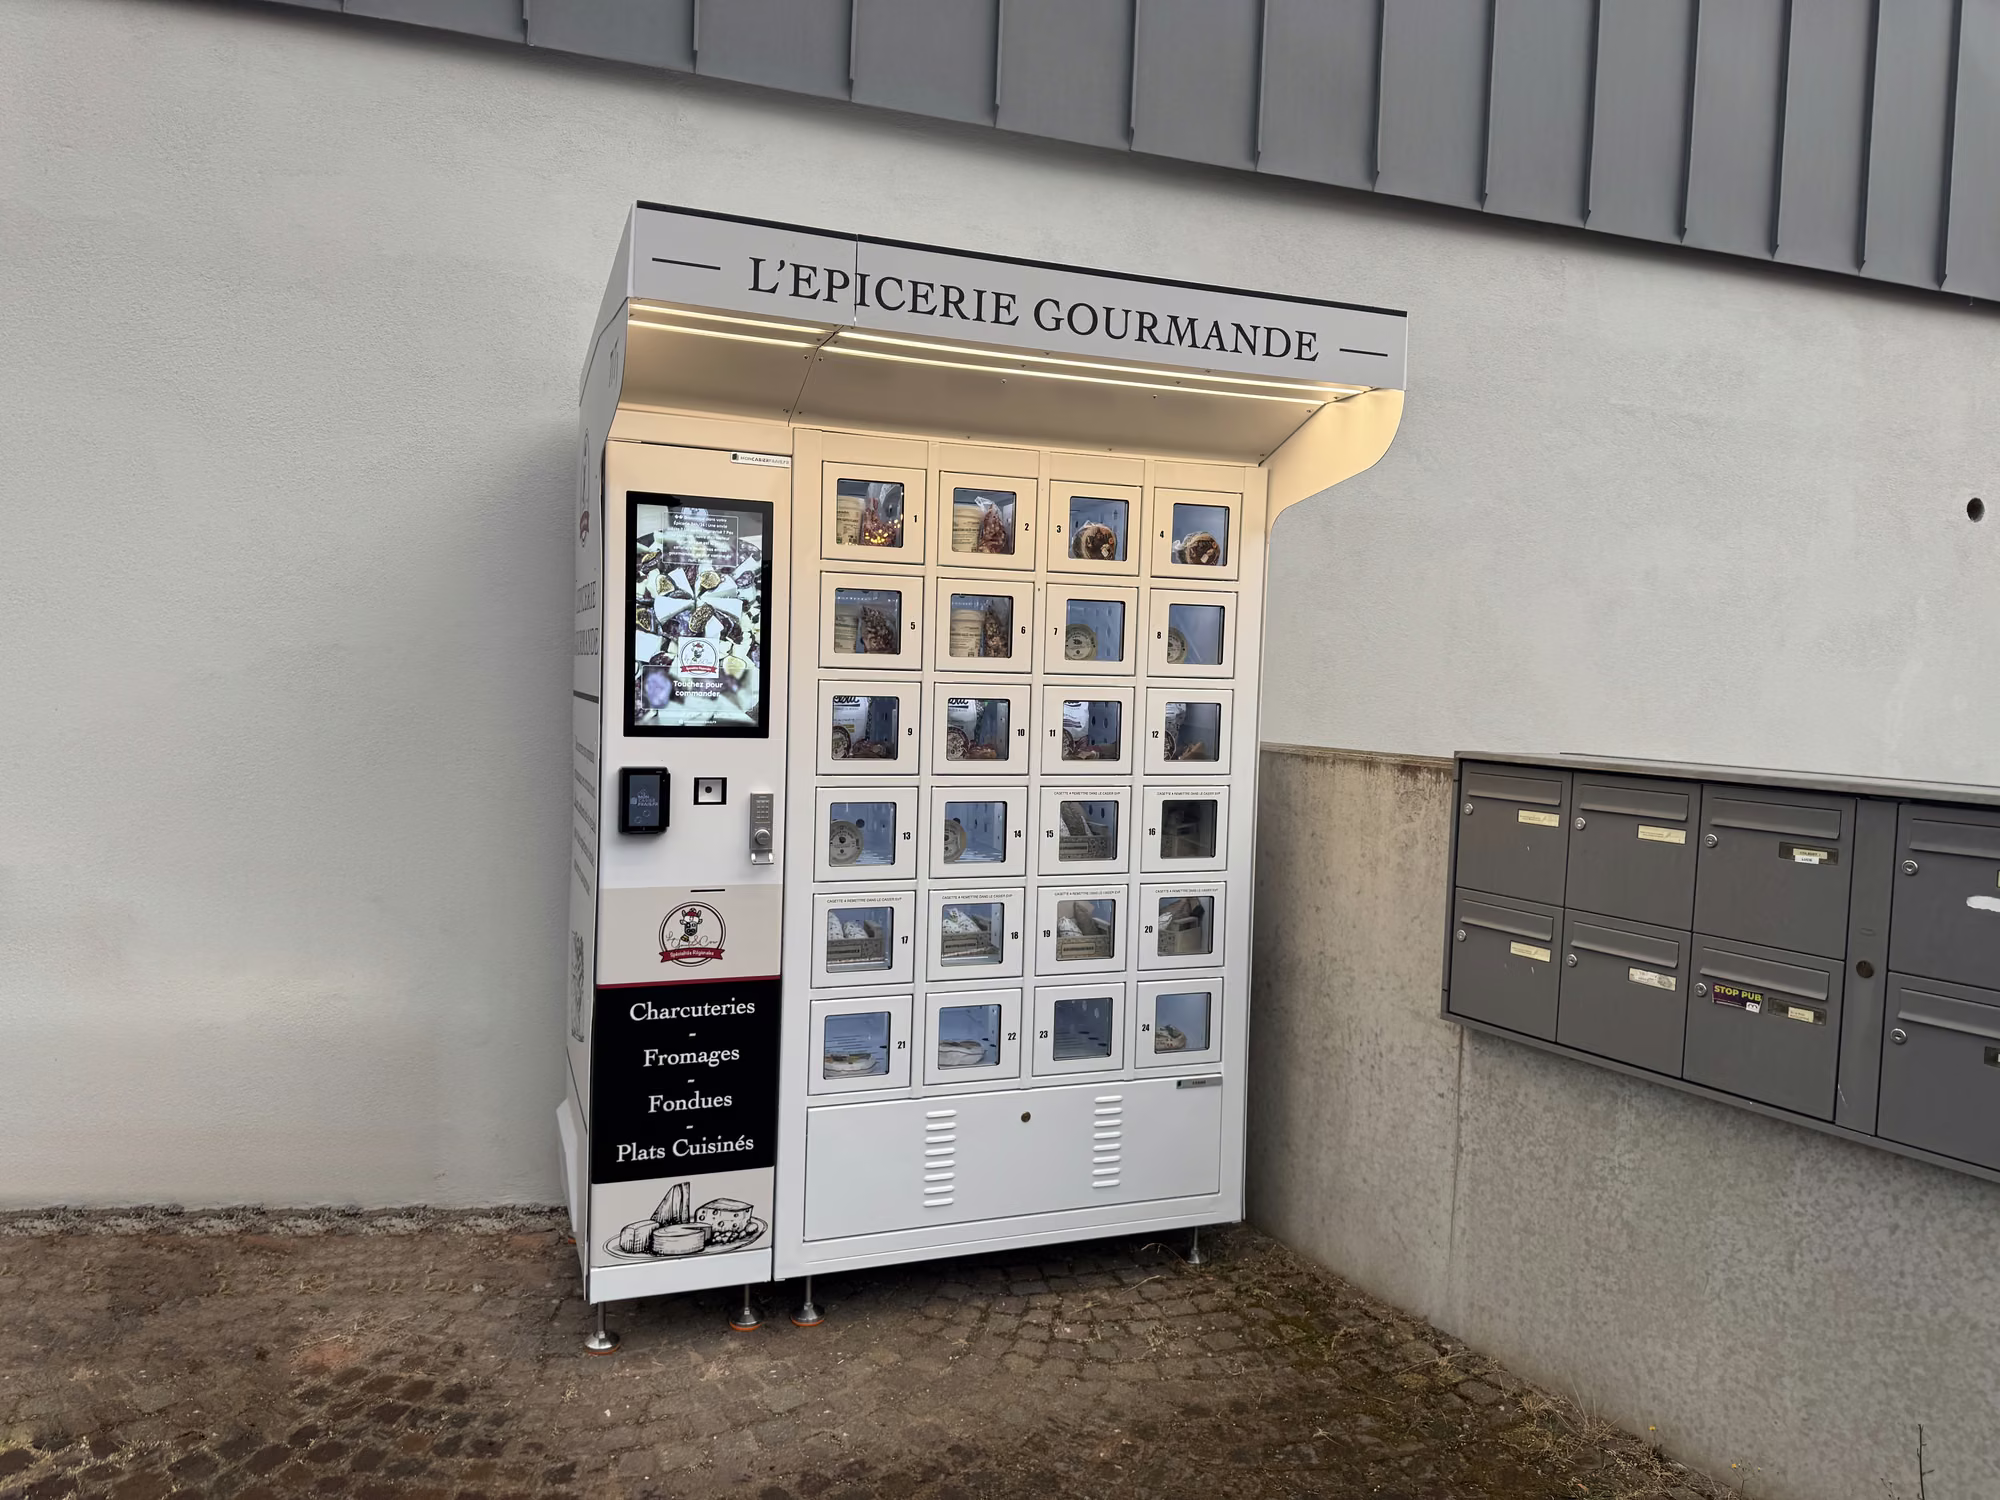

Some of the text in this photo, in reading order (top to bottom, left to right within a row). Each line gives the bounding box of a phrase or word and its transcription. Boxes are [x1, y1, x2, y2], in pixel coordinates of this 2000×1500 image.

[1033, 298, 1320, 362] GOURMANDE
[913, 514, 918, 523] 1
[1024, 523, 1030, 531] 2
[1056, 525, 1062, 533] 3
[1159, 530, 1165, 538] 4
[910, 621, 916, 630] 5
[1020, 626, 1026, 634] 6
[1053, 627, 1058, 636] 7
[1156, 631, 1162, 640] 8
[674, 680, 706, 688] Touchez
[907, 727, 913, 736] 9
[1017, 728, 1025, 737] 10
[1049, 729, 1056, 737] 11
[1152, 730, 1159, 739] 12
[902, 832, 911, 840] 13
[1014, 830, 1022, 838] 14
[1046, 830, 1054, 838] 15
[1148, 828, 1156, 836] 16
[1043, 930, 1051, 938] 19
[1144, 925, 1153, 934] 20
[901, 936, 909, 944] 17
[1010, 932, 1019, 940] 18
[1714, 985, 1762, 1001] STOP PUB
[629, 998, 756, 1021] Charcuteries
[1141, 1023, 1150, 1032] 24
[1007, 1032, 1017, 1040] 22
[1039, 1030, 1048, 1039] 23
[897, 1041, 906, 1049] 21
[643, 1046, 740, 1068] Fromages
[648, 1090, 732, 1114] Fondues
[616, 1134, 754, 1162] Plats Cuisinés
